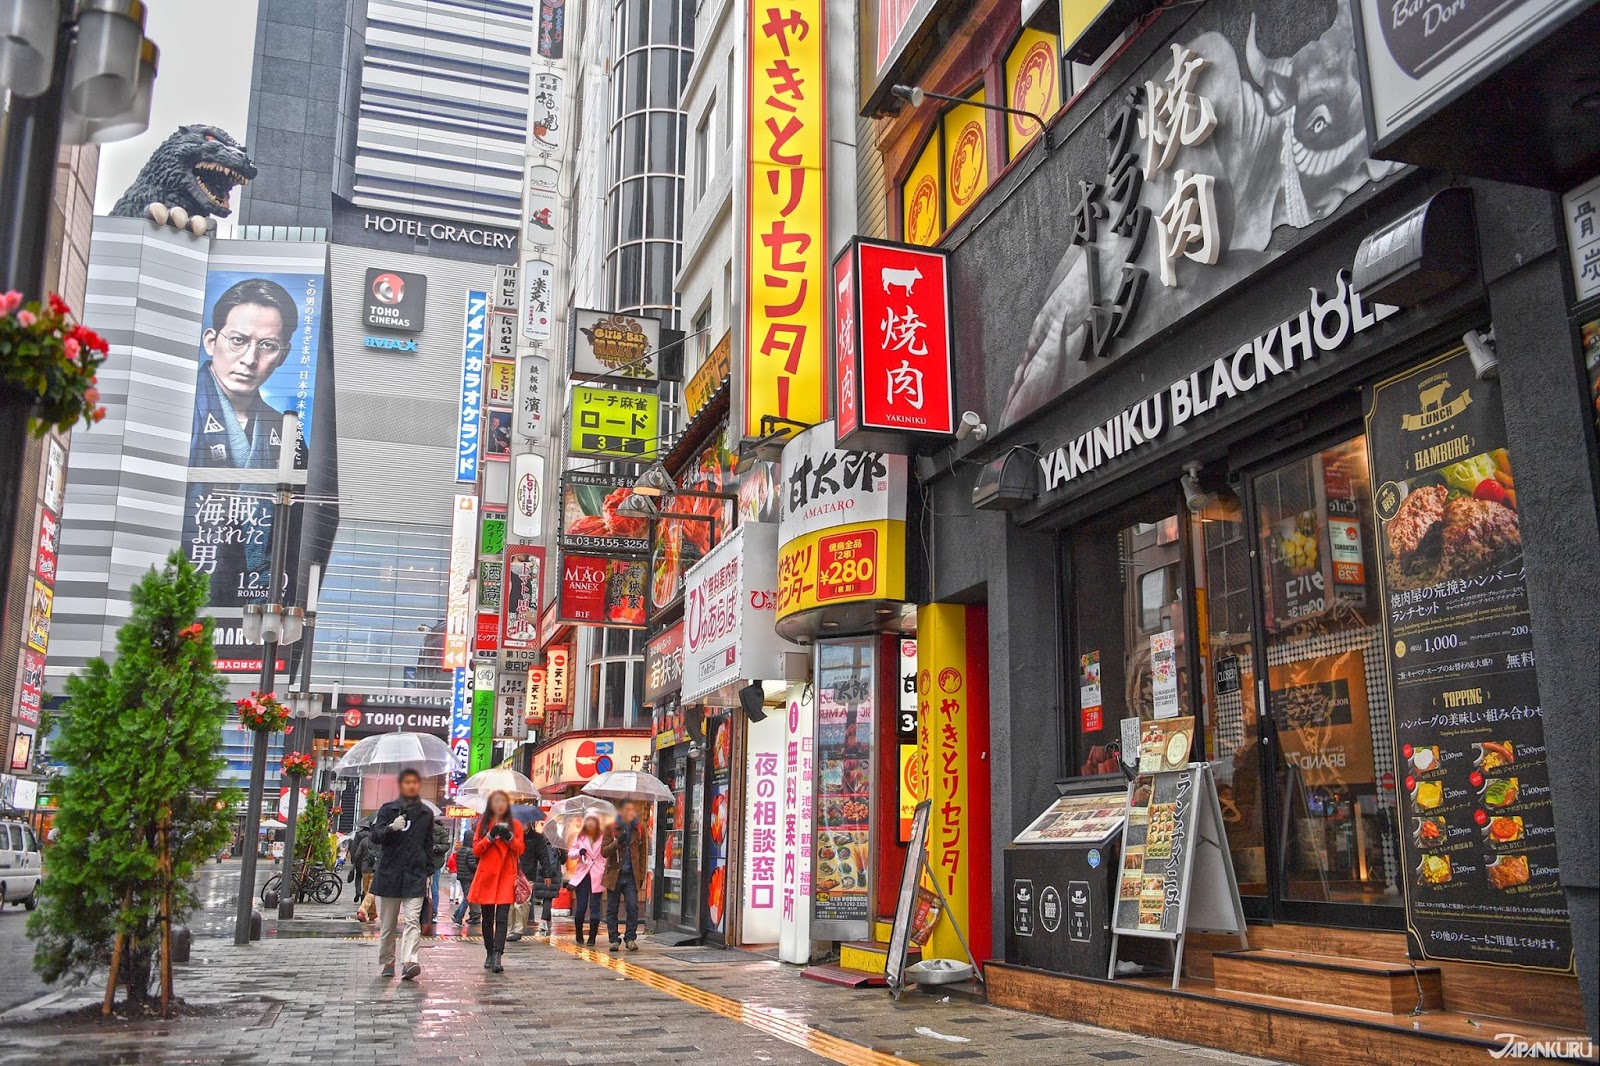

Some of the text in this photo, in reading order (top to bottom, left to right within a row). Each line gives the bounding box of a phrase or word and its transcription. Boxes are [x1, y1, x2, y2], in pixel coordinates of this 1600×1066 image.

[1139, 43, 1219, 287] 焼肉
[761, 8, 812, 418] やきとりセンター
[1104, 86, 1152, 337] ブラック
[364, 214, 516, 250] HOTEL GRACERY
[369, 315, 410, 327] CINEMAS
[370, 305, 400, 317] TOHO
[364, 335, 419, 352] IMAX
[1170, 270, 1399, 427] BLACKHOL
[839, 308, 853, 415] 焼肉
[880, 306, 928, 410] 焼肉
[583, 393, 648, 412] リーチ麻雀
[580, 410, 649, 436] ロード
[886, 414, 927, 425] YAKINIKU
[1420, 405, 1453, 426] LUNCH
[1039, 393, 1163, 492] YAKINIKU
[1414, 434, 1470, 471] HAMBURG
[789, 451, 887, 514] 甘太郎
[194, 494, 272, 527] 海賊と
[803, 498, 855, 521] AMATARO
[191, 525, 265, 545] よばれた
[189, 545, 219, 575] 男
[238, 572, 288, 591] 12.
[569, 581, 599, 591] ANNEX
[1392, 601, 1440, 623] ランチセット
[1510, 625, 1529, 637] 200
[1425, 633, 1458, 653] 1,000
[1506, 650, 1536, 670] 無料
[1217, 668, 1236, 683] CLOSED
[825, 680, 869, 701] 太郎
[1443, 688, 1483, 708] TOPPING
[365, 712, 405, 726] TOHO
[940, 698, 961, 895] やきとりセンター
[751, 752, 779, 909] 夜の相談窓口
[783, 740, 799, 923] 無料案内所
[1162, 772, 1191, 929] ランチメニュー
